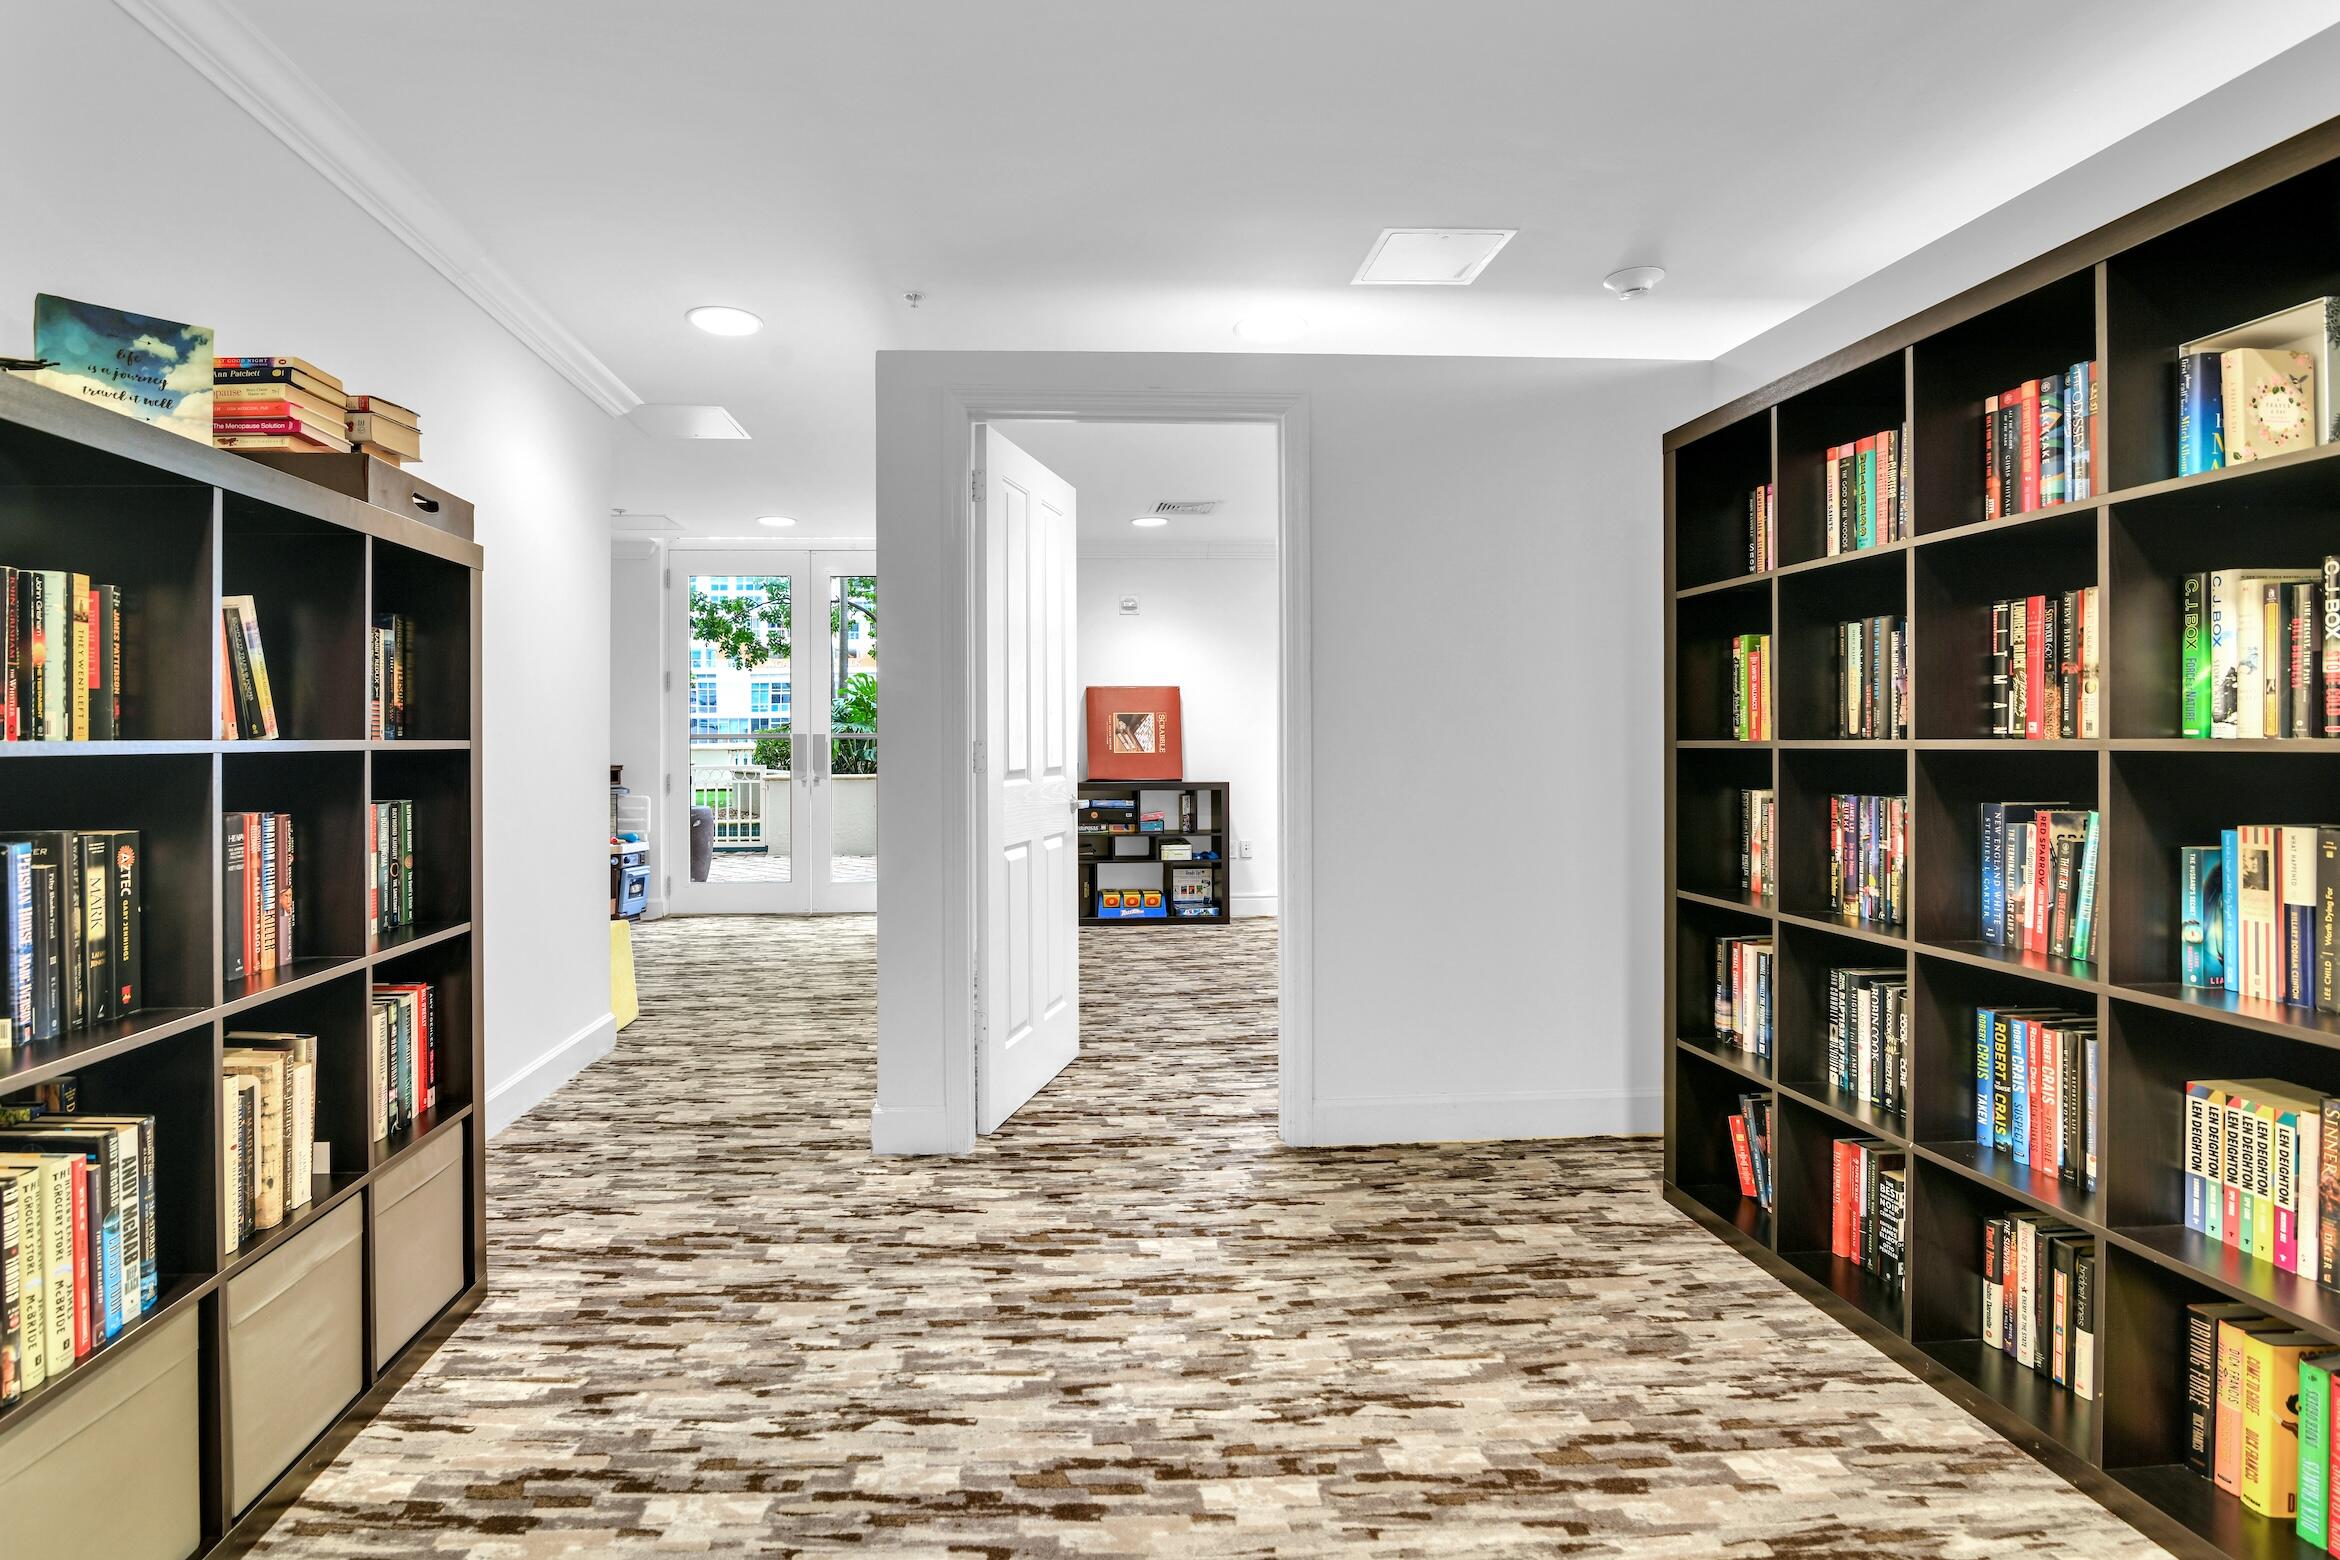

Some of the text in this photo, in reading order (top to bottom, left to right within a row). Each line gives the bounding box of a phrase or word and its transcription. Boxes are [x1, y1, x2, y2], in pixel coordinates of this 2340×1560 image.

[87, 364, 168, 391] is a journey
[116, 349, 142, 366] life
[82, 385, 174, 410] travel it well
[2072, 370, 2084, 451] THE ODYSSEY
[225, 423, 261, 431] Menopause
[2040, 400, 2050, 465] BLACK CAKE
[2181, 415, 2190, 472] Mitch Albom
[35, 577, 43, 600] John
[2184, 579, 2199, 650] C. J. BOX
[2212, 576, 2222, 648] C. J. BOX
[2014, 601, 2026, 642] LAWRENCE
[77, 660, 85, 691] WENT
[2014, 643, 2026, 669] BLOCK
[77, 696, 85, 719] LEFT
[2186, 658, 2197, 721] FORCE NATURE
[1158, 714, 1166, 753] SCRABBLE
[120, 853, 132, 897] AZTEC
[263, 817, 275, 910] JONATHAN KELLERMAN
[2038, 837, 2046, 887] SPARROW
[17, 853, 33, 947] PERSIAN HORSE
[90, 877, 103, 930] MARK
[264, 914, 275, 951] KILLER
[2291, 911, 2300, 1000] HILLARY RODHAM CLINTON
[2324, 961, 2332, 985] CHILD
[1839, 1038, 1845, 1052] OF
[1871, 988, 1879, 1062] ROBIN COOK
[1977, 1013, 1989, 1080] ROBERT CRAIS
[1995, 1022, 2006, 1081] ROBERT
[2012, 1024, 2024, 1093] ROBERT CRAIS
[2042, 1033, 2055, 1105] ROBERT CRAIS
[285, 1055, 295, 1140] Cilka's Journey
[1978, 1093, 1987, 1126] TAKEN
[1995, 1093, 2006, 1135] CRAIS
[2014, 1102, 2023, 1146] SUSPECT
[2044, 1117, 2052, 1164] FIRST RULE
[2192, 1100, 2202, 1172] LEN DEIGHTON
[2208, 1106, 2219, 1179] LEN DEIGHTON
[2227, 1110, 2238, 1185] LEN DEIGHTON
[2241, 1115, 2253, 1191] LEN DEIGHTON
[2257, 1120, 2267, 1197] LEN DEIGHTON
[2322, 1108, 2339, 1176] SINNER
[109, 1138, 118, 1207] ANDY McNAB
[1880, 1183, 1899, 1199] BEST
[2279, 1127, 2290, 1206] LEN DEIGHTON
[53, 1184, 64, 1262] GROCERY STORE
[121, 1155, 138, 1266] ANDY McNAB
[1879, 1198, 1899, 1214] NOIR
[24, 1196, 35, 1276] GROCERY STORE
[26, 1295, 37, 1351] McBRIDE
[55, 1280, 65, 1335] McBRIDE
[2021, 1313, 2028, 1321] OF
[2189, 1318, 2211, 1408] DRIVING FORCE
[2228, 1348, 2240, 1404] DICK FRANCIS
[2245, 1428, 2259, 1483] DICK FRANCIS
